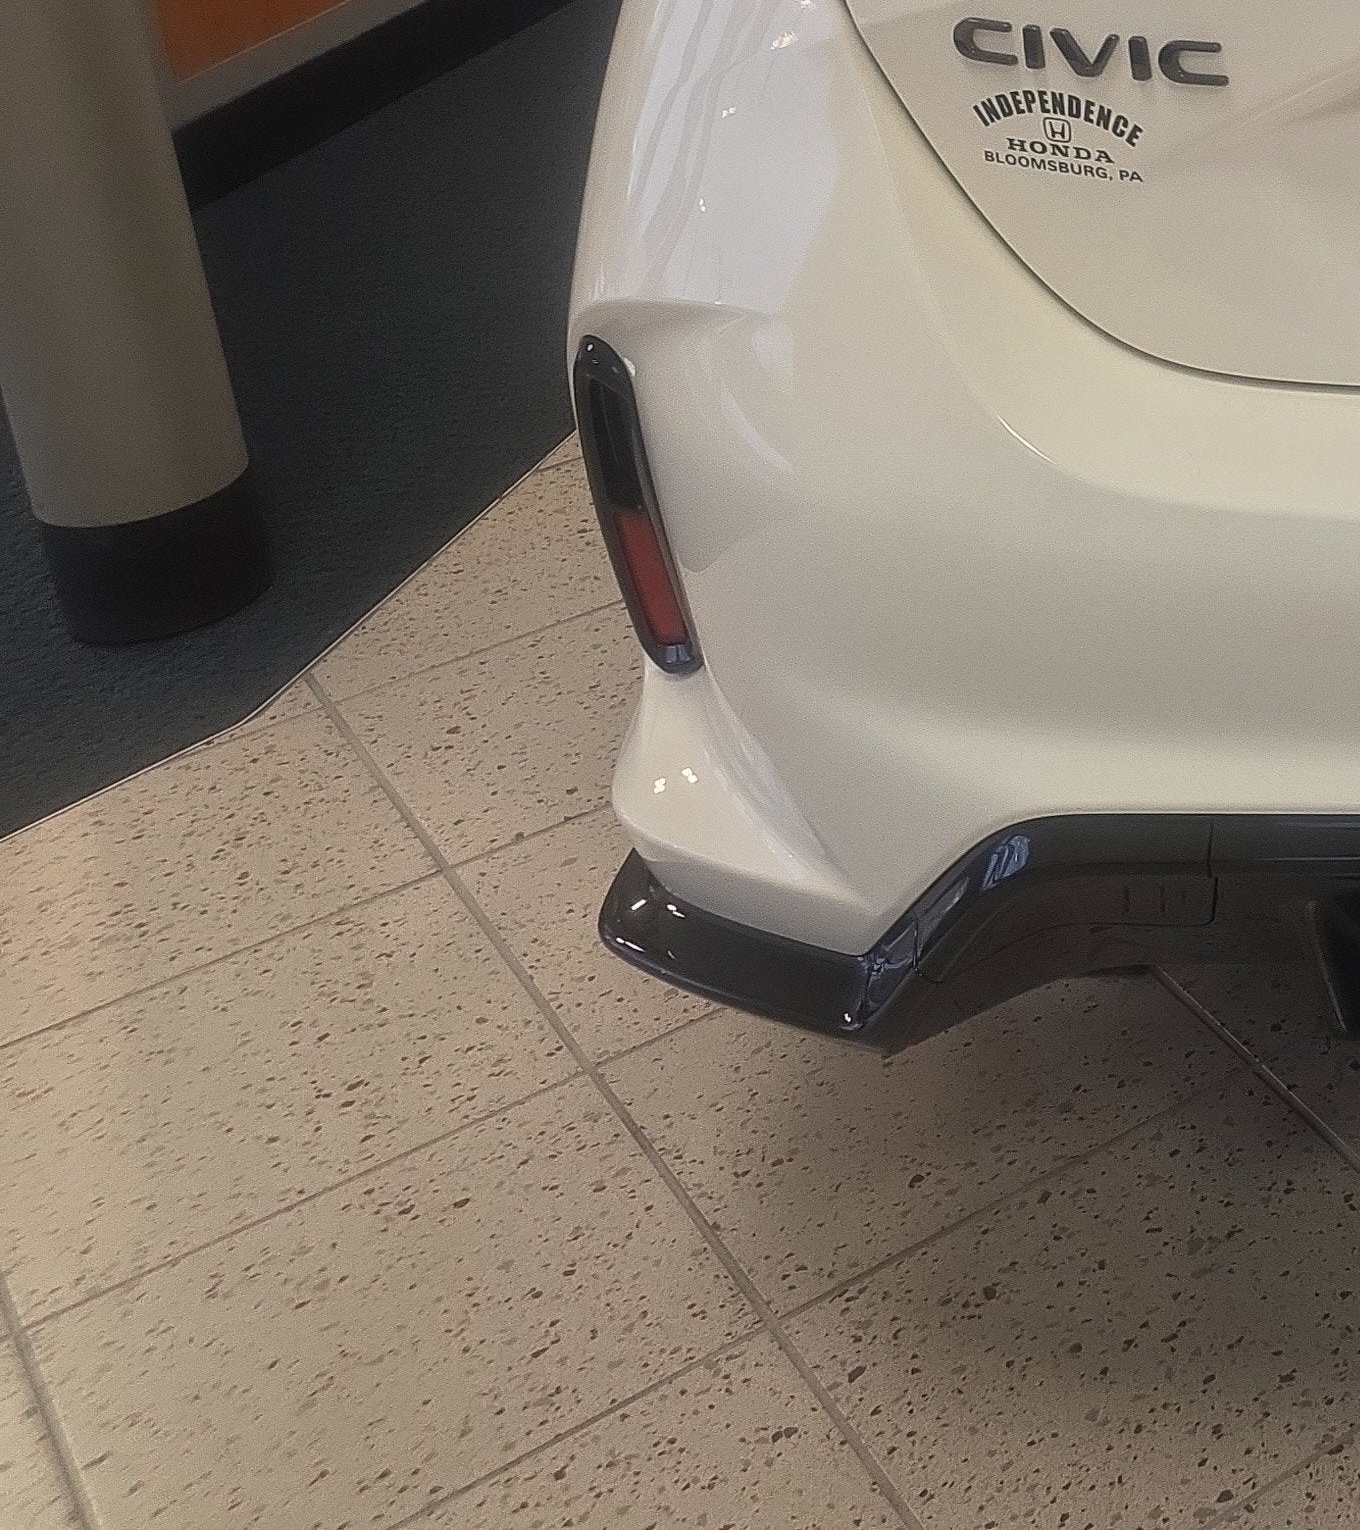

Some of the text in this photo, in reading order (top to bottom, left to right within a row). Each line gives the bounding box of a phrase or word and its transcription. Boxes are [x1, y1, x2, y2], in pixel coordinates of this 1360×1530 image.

[953, 16, 1230, 87] CIVIC
[973, 90, 1144, 148] INDEPENDENCE
[984, 150, 1144, 183] BLOOMSBURG, PA
[1006, 137, 1116, 164] HONDA
